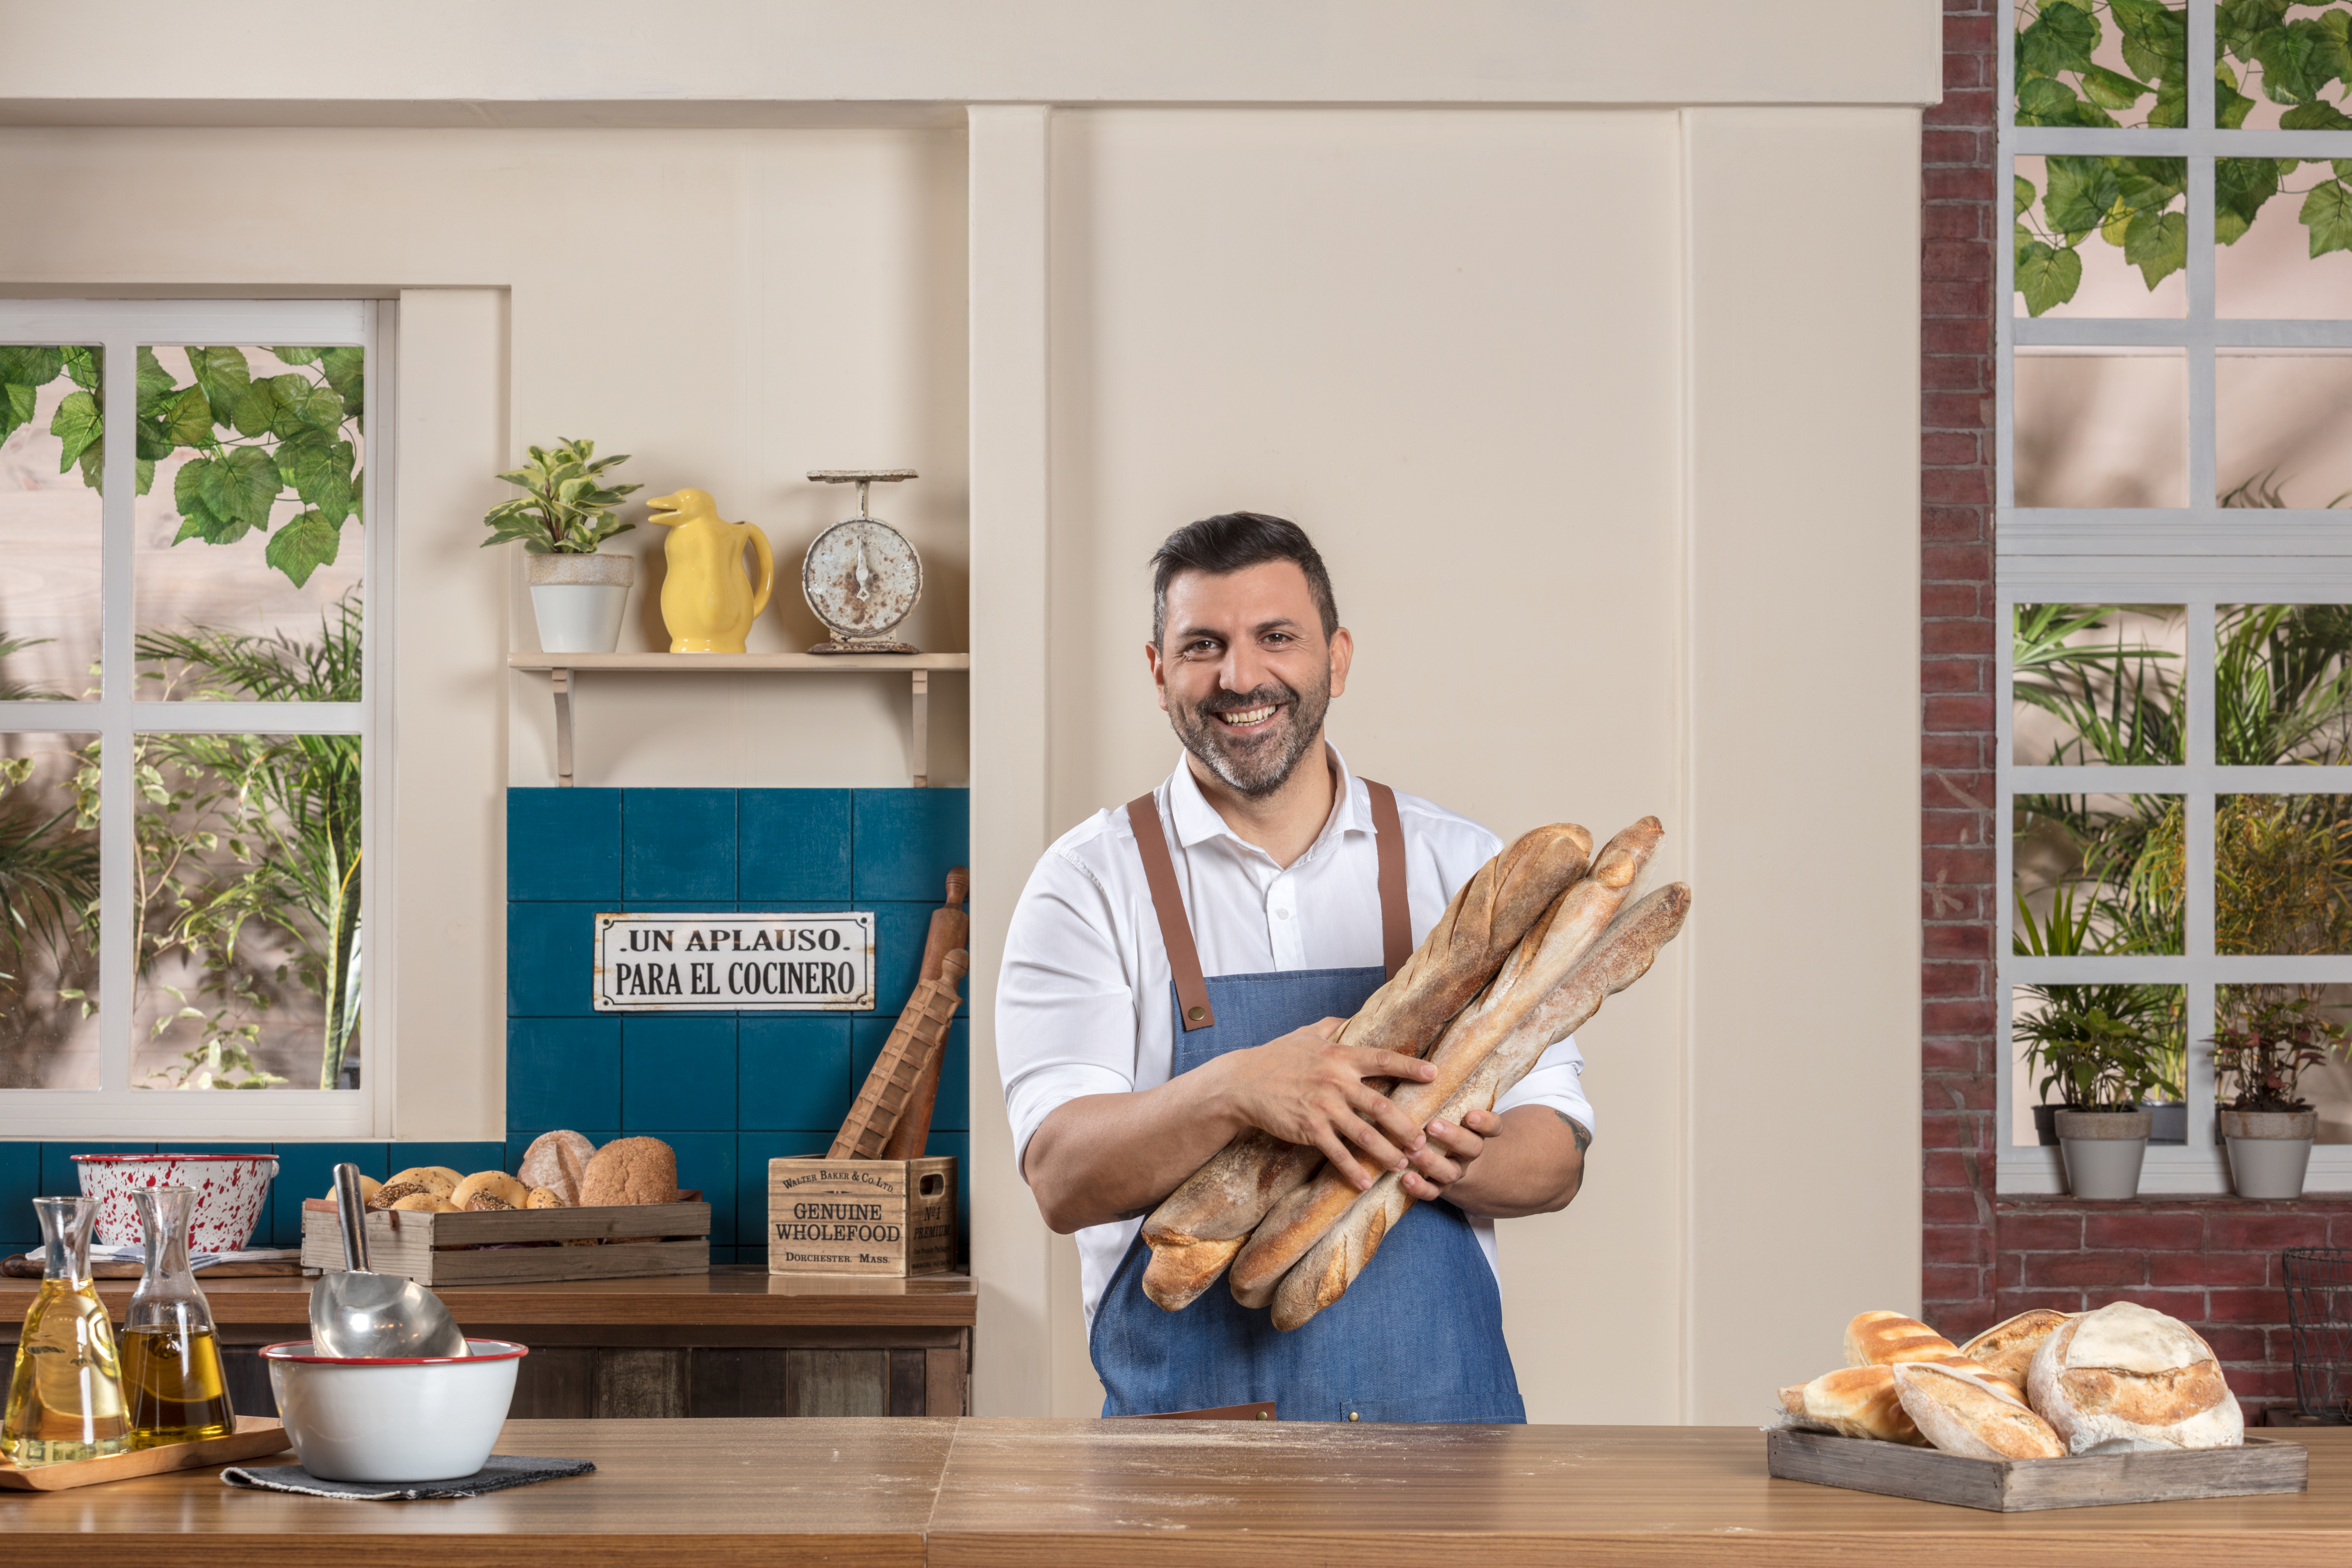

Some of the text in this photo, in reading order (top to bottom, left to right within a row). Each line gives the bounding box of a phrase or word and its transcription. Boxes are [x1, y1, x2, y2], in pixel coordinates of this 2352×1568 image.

[616, 961, 855, 995] PARA EL COCINERO
[852, 1171, 860, 1181] &
[794, 1202, 882, 1221] GENUINE
[776, 1224, 900, 1242] WHOLEFOOD
[913, 1224, 950, 1240] PREMIUM
